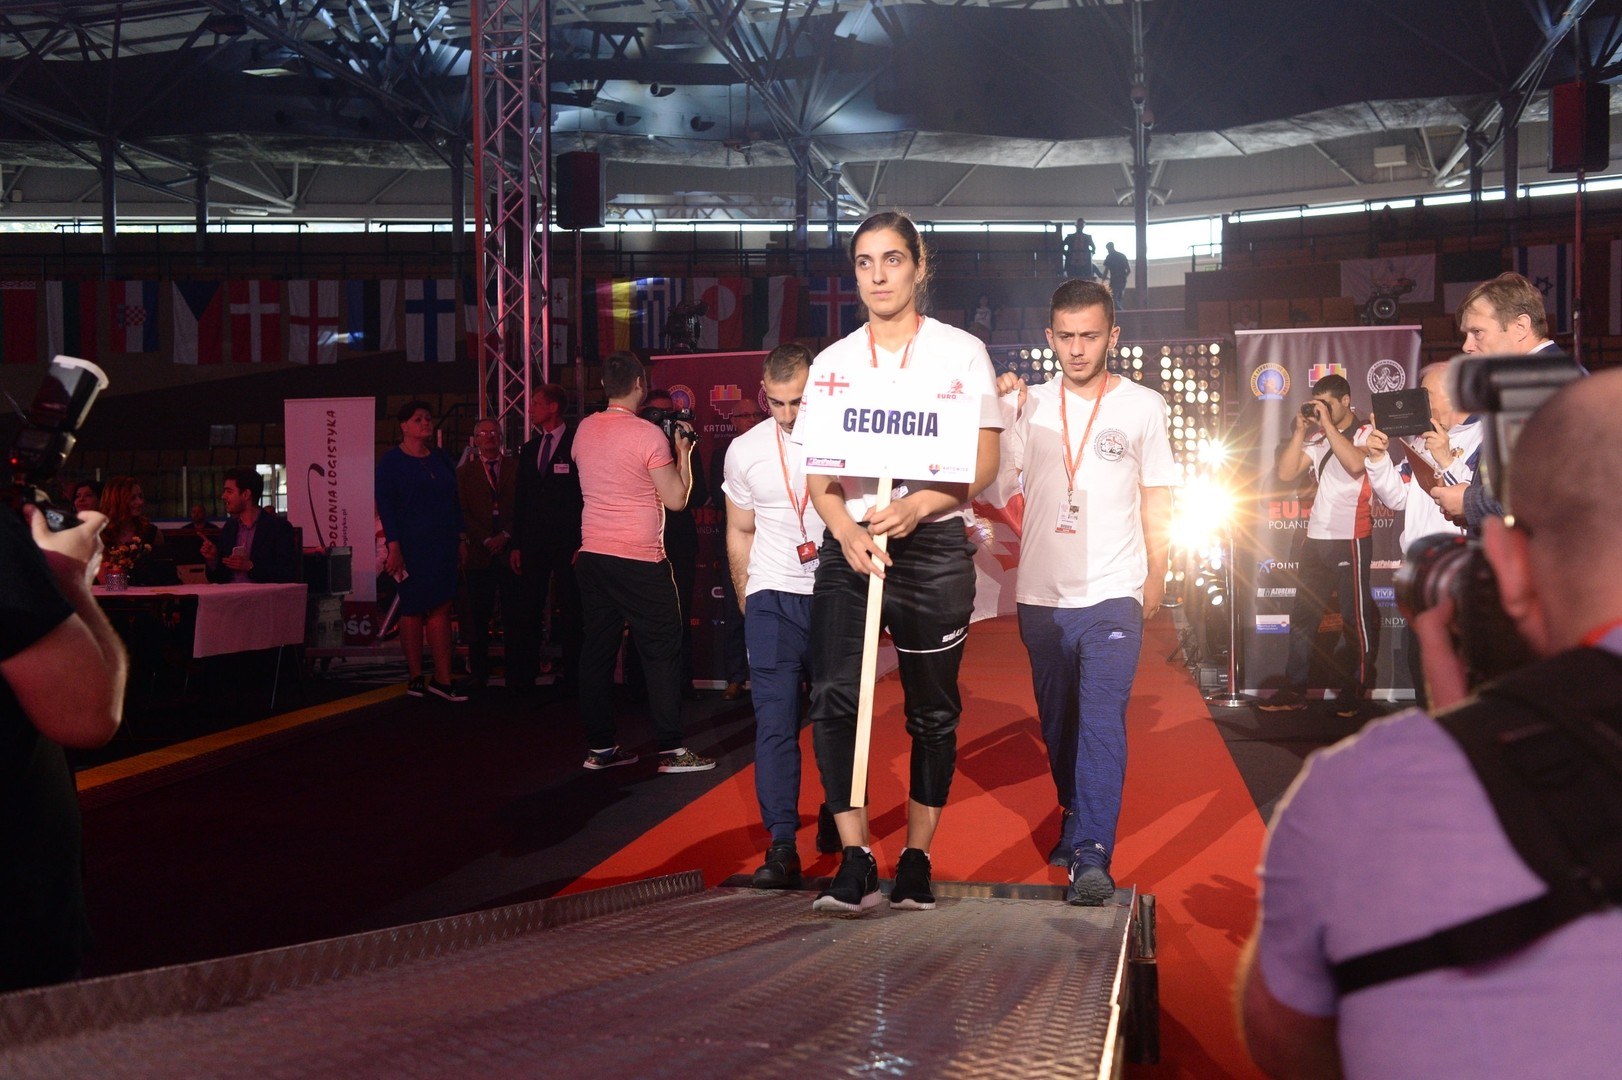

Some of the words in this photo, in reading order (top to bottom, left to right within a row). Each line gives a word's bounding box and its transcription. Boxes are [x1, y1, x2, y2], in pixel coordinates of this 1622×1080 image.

[842, 407, 939, 437] GEORGIA
[326, 410, 337, 486] LOGISTYKA
[328, 490, 338, 548] POLONIA
[341, 508, 349, 548] ogistyka.pl
[1268, 520, 1309, 530] POLAND
[1372, 518, 1395, 528] 2017
[1376, 589, 1395, 598] TVP
